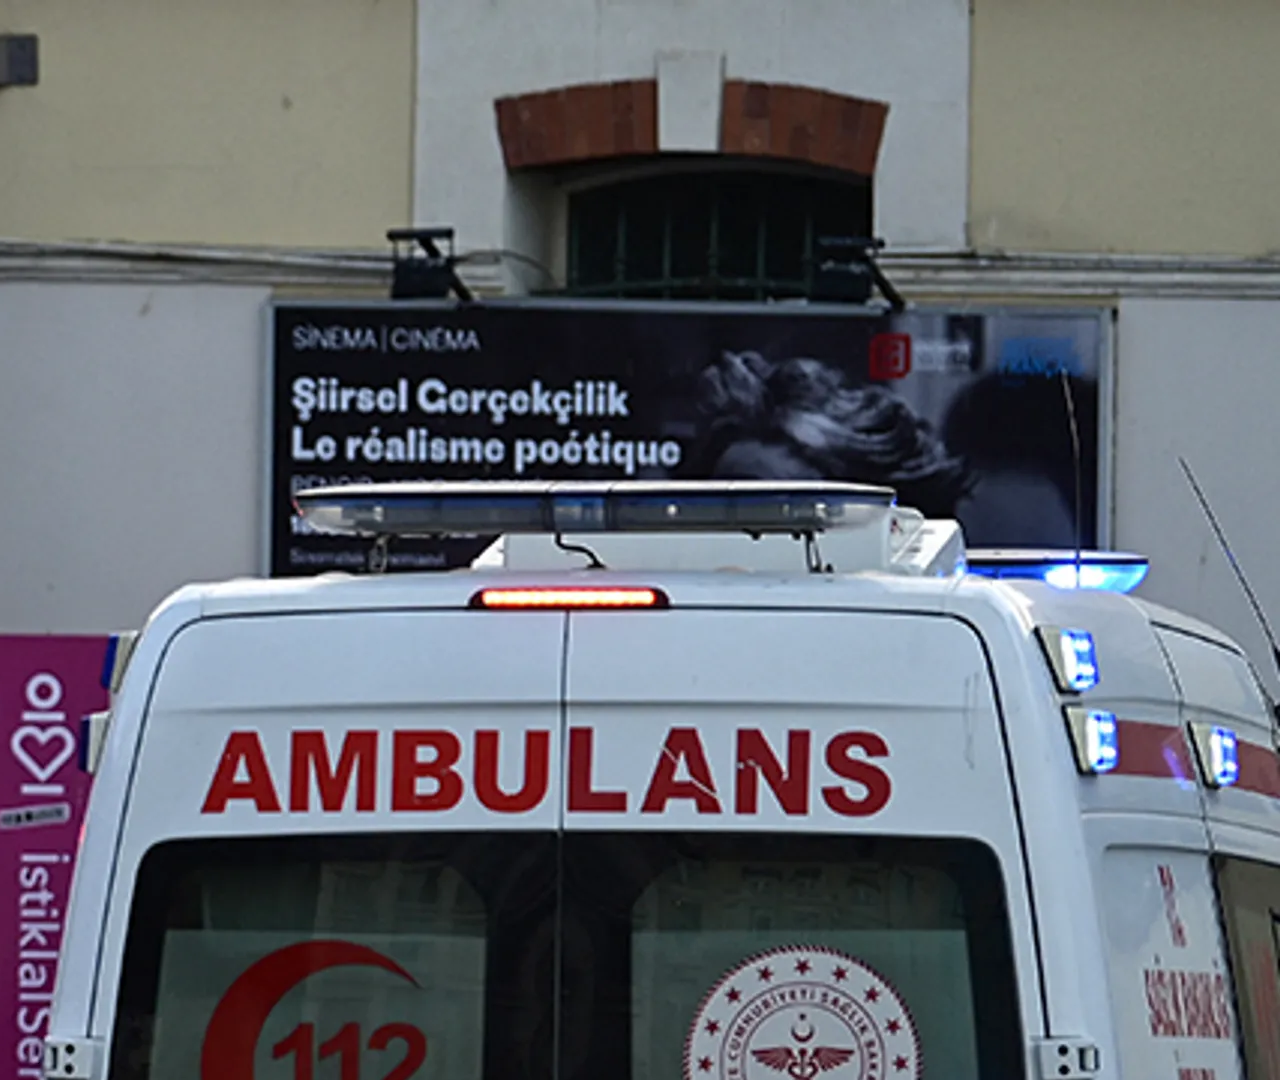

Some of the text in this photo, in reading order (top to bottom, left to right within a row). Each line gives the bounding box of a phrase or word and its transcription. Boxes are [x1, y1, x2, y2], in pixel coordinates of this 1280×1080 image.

[292, 376, 629, 424] Şiirsel Gerçekçilik
[291, 426, 681, 475] Le réalisme poétique
[202, 726, 891, 817] AMBULANS
